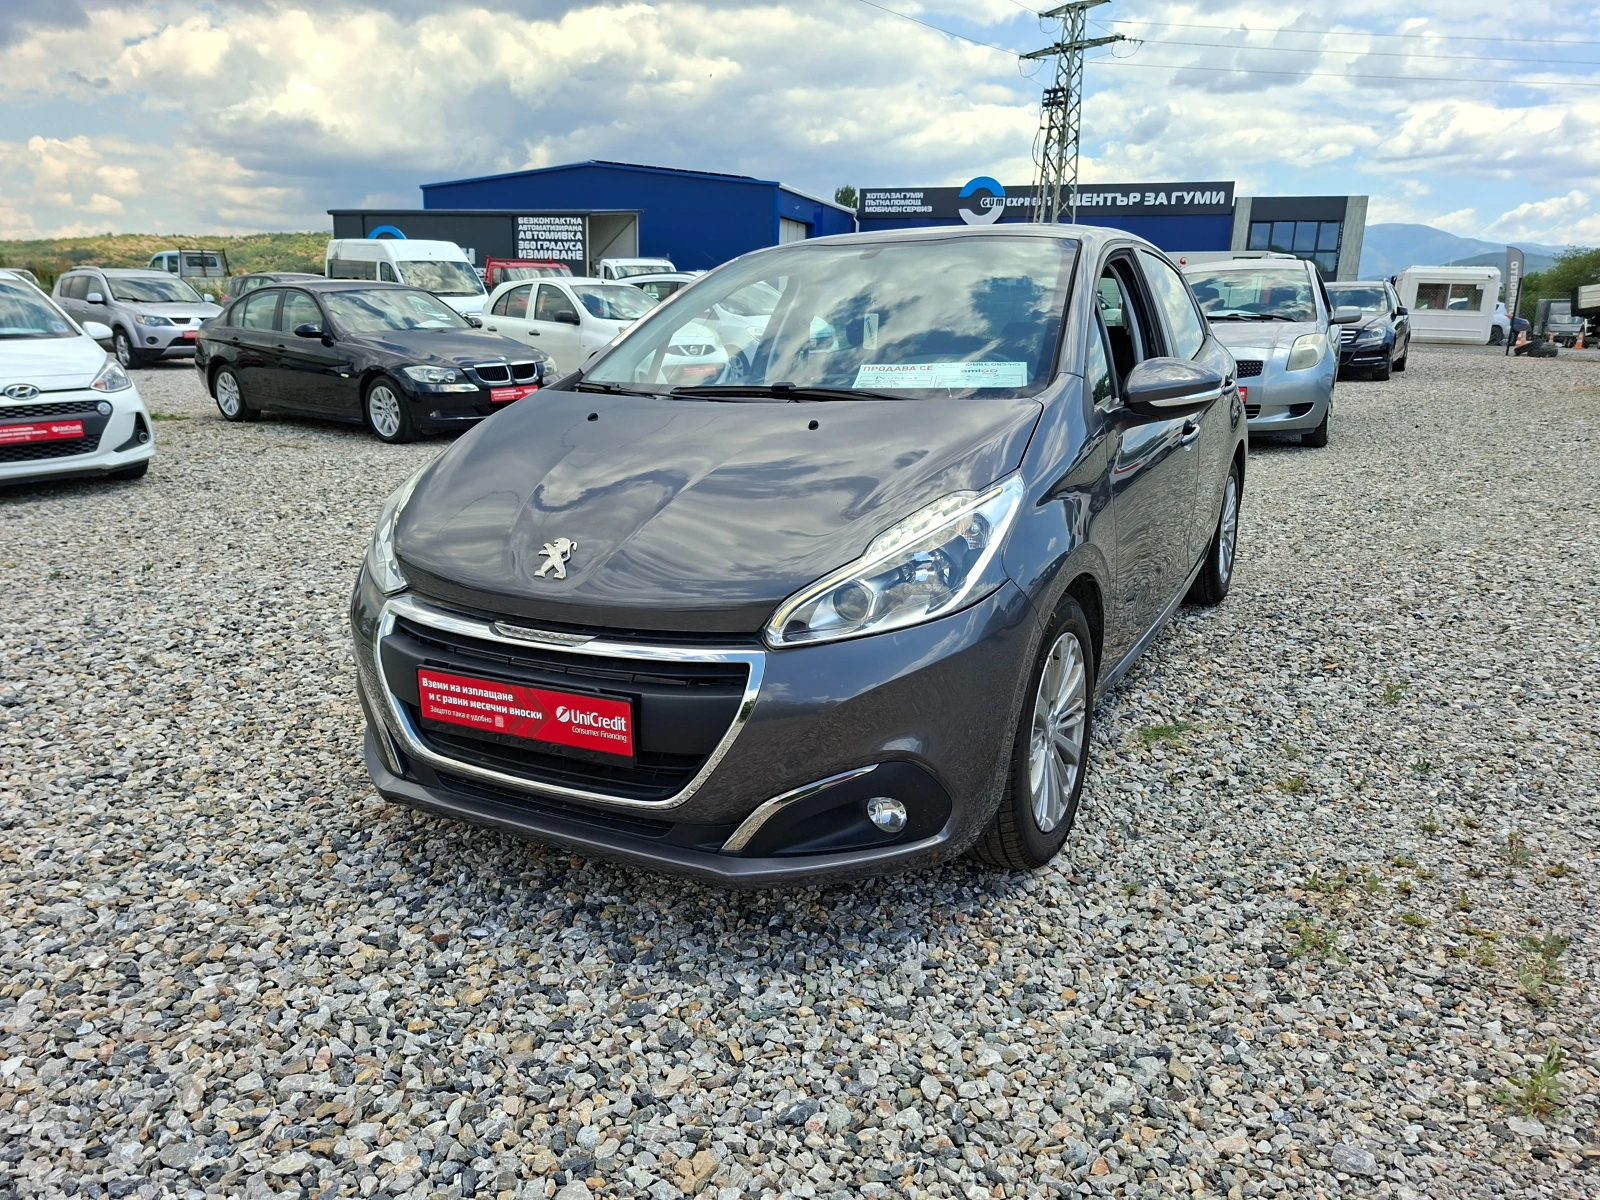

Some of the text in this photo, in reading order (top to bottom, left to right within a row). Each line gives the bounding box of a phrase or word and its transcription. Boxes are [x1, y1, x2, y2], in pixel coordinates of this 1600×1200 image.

[981, 197, 1004, 207] GUM
[1069, 191, 1225, 207] ЦЕНТЪР ЗА ГУМИ
[518, 217, 583, 225] БЕЗКОНТАКТНА
[518, 224, 583, 232] АВТОМАТИЗИРАНА
[518, 231, 583, 241] АВТОМИВКА
[518, 240, 583, 250] 360 ГРАДУСА
[518, 249, 583, 260] ИЗМИВАНЕ
[422, 677, 514, 702] Вземи на изплащане
[430, 705, 451, 715] Защото
[452, 710, 466, 718] така
[470, 713, 492, 723] удобно
[442, 695, 468, 706] равни
[470, 700, 507, 713] месечни
[509, 707, 542, 720] вноски
[571, 709, 626, 732] UniCredit
[572, 725, 627, 743] Consumer Financing
